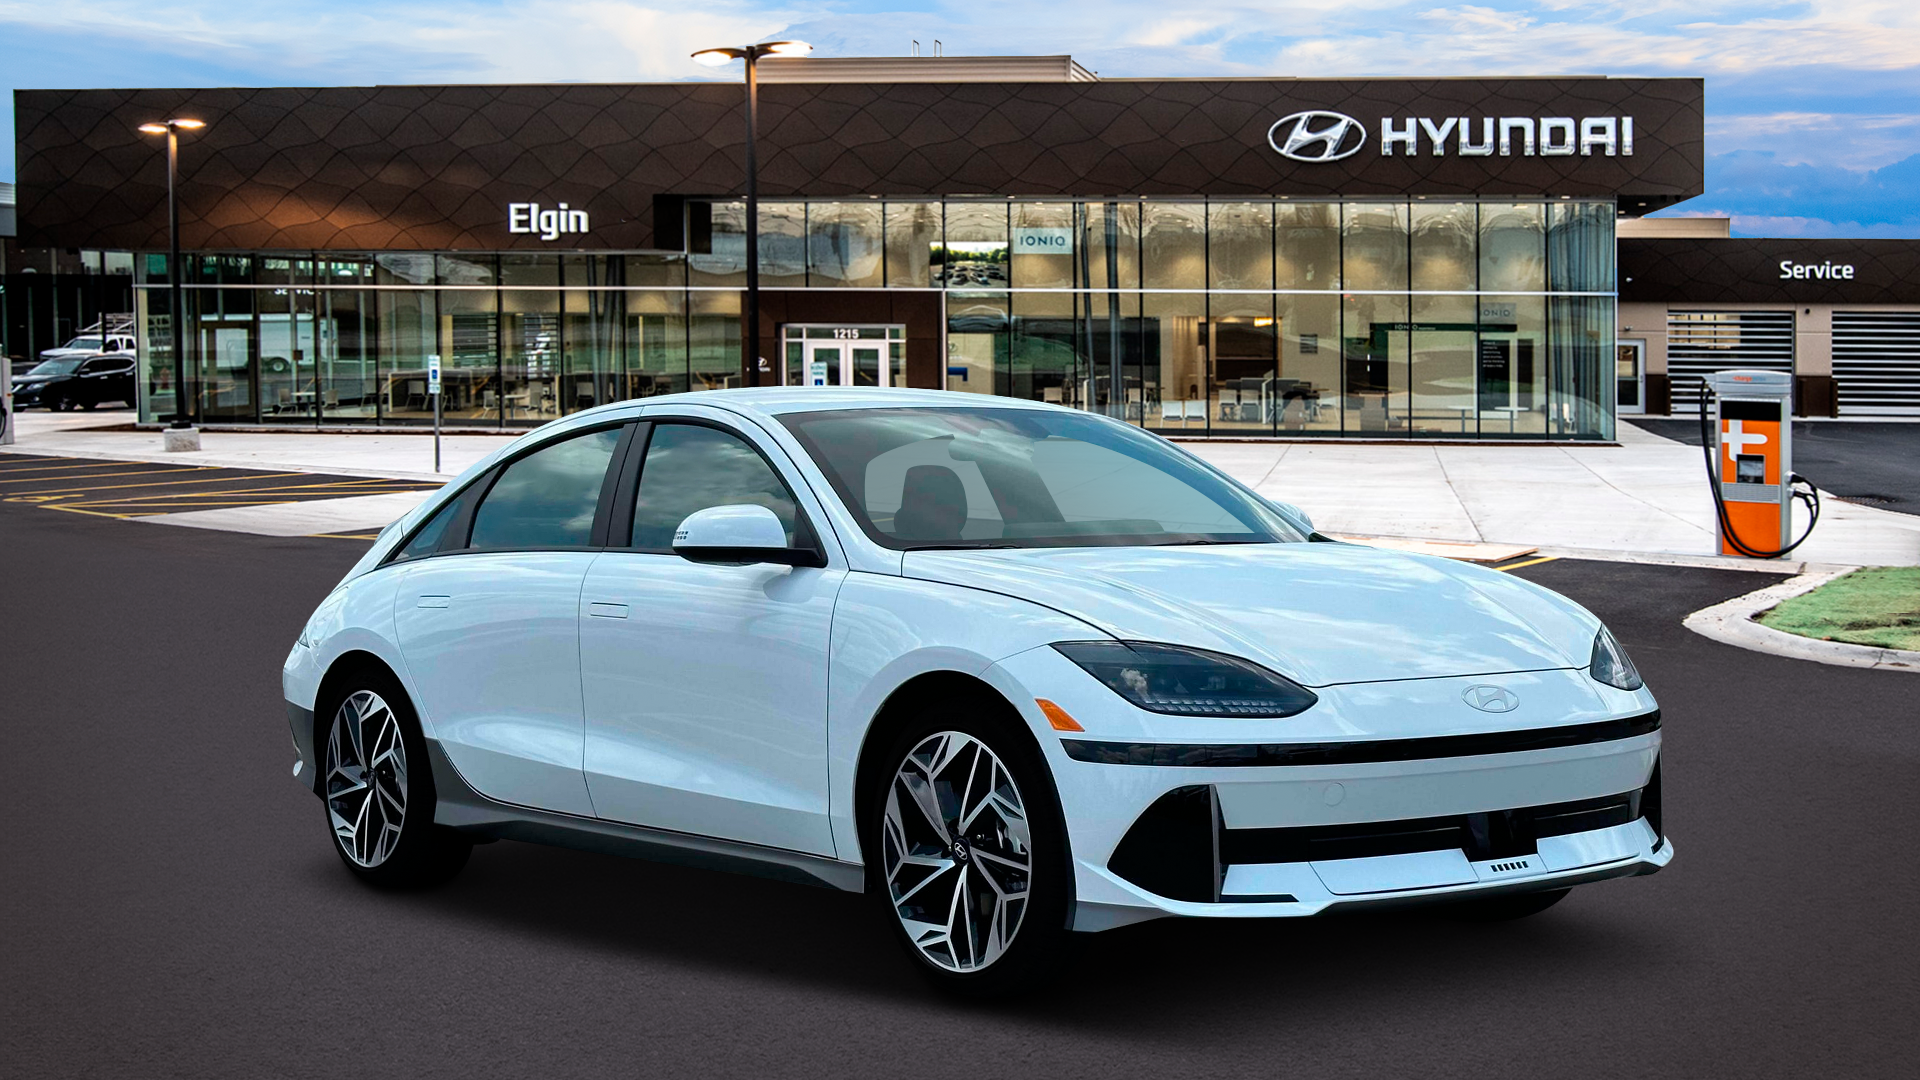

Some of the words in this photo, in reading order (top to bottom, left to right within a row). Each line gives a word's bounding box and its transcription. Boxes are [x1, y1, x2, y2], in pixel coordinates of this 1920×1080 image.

[1381, 116, 1634, 157] HYUNDAI
[509, 203, 589, 241] Elgin
[1020, 235, 1066, 246] IONIQ
[1779, 260, 1854, 279] Service
[833, 328, 859, 339] 1215
